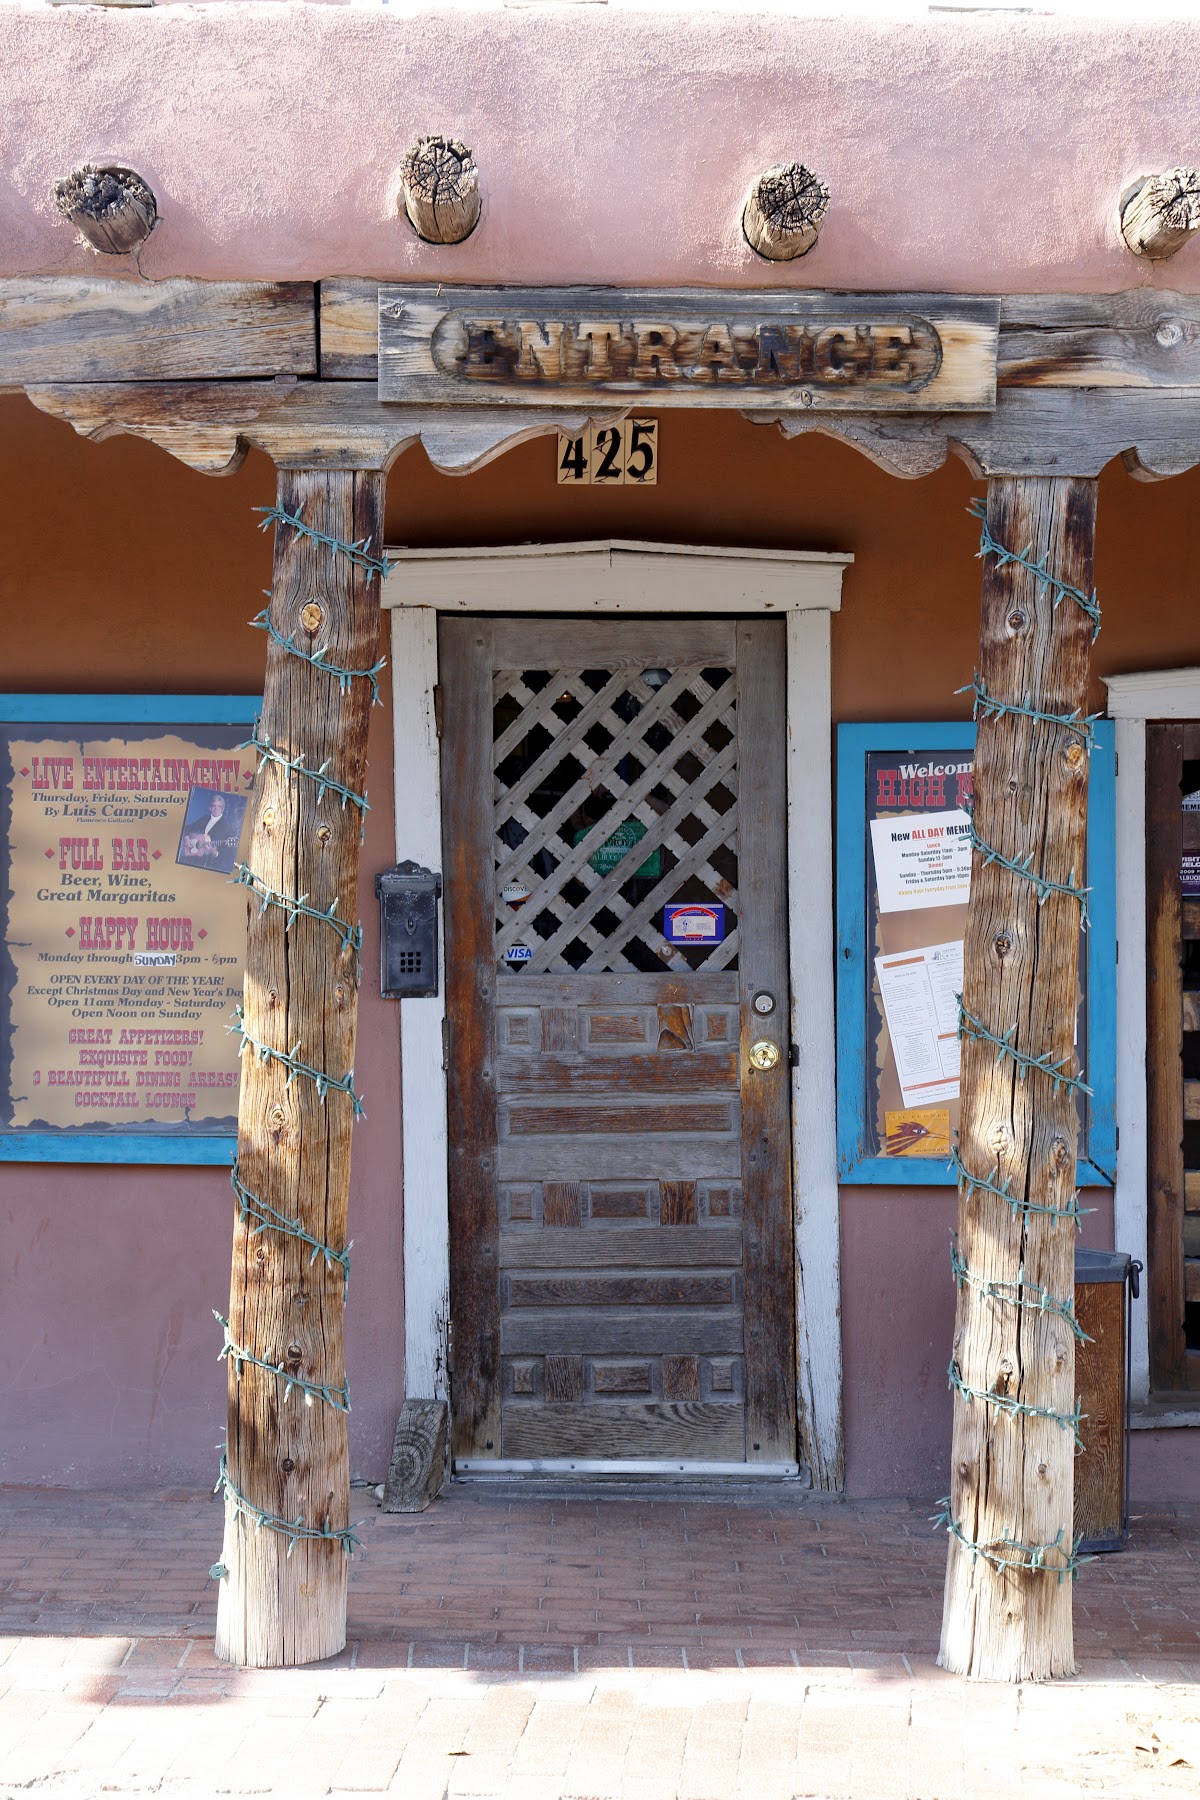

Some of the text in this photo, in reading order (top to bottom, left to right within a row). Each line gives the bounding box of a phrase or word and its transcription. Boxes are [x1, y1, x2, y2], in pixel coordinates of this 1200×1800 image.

[463, 320, 913, 381] ENTRANCE
[560, 427, 655, 479] 425
[32, 757, 241, 792] LIVE ENTERTAINMENT!
[877, 770, 946, 806] HIGH
[32, 793, 187, 805] Thursday, Friday, Saturday
[44, 805, 168, 820] By Luis Campos
[891, 824, 970, 842] New ALL DAY MENU
[59, 838, 150, 871] FULL BAR
[60, 874, 152, 888] Beer, Wine,
[36, 889, 176, 905] Great Margaritas
[79, 916, 194, 950] HAPPY HOUR
[37, 953, 84, 965] Monday
[87, 953, 133, 965] through
[134, 955, 176, 966] SUNDAY
[176, 954, 201, 965] 3pm
[506, 948, 532, 958] VISA
[50, 975, 225, 986] OPEN EVERY DAY OF THE YEAR!
[27, 986, 244, 999] Except Christmas Day and New Year's Day
[47, 997, 79, 1008] Open
[83, 997, 115, 1007] 11am
[117, 998, 164, 1008] Monday
[174, 998, 226, 1009] Saturday
[72, 1008, 202, 1020] Open Noon on Sunday
[69, 1028, 204, 1045] GREAT APPETIZERS!
[79, 1050, 193, 1067] EXQUISITE FOOD!
[32, 1070, 239, 1088] 3 BEAUTIFULL DINING AREAS!
[75, 1091, 197, 1108] COCKTAIL LOUNGE
